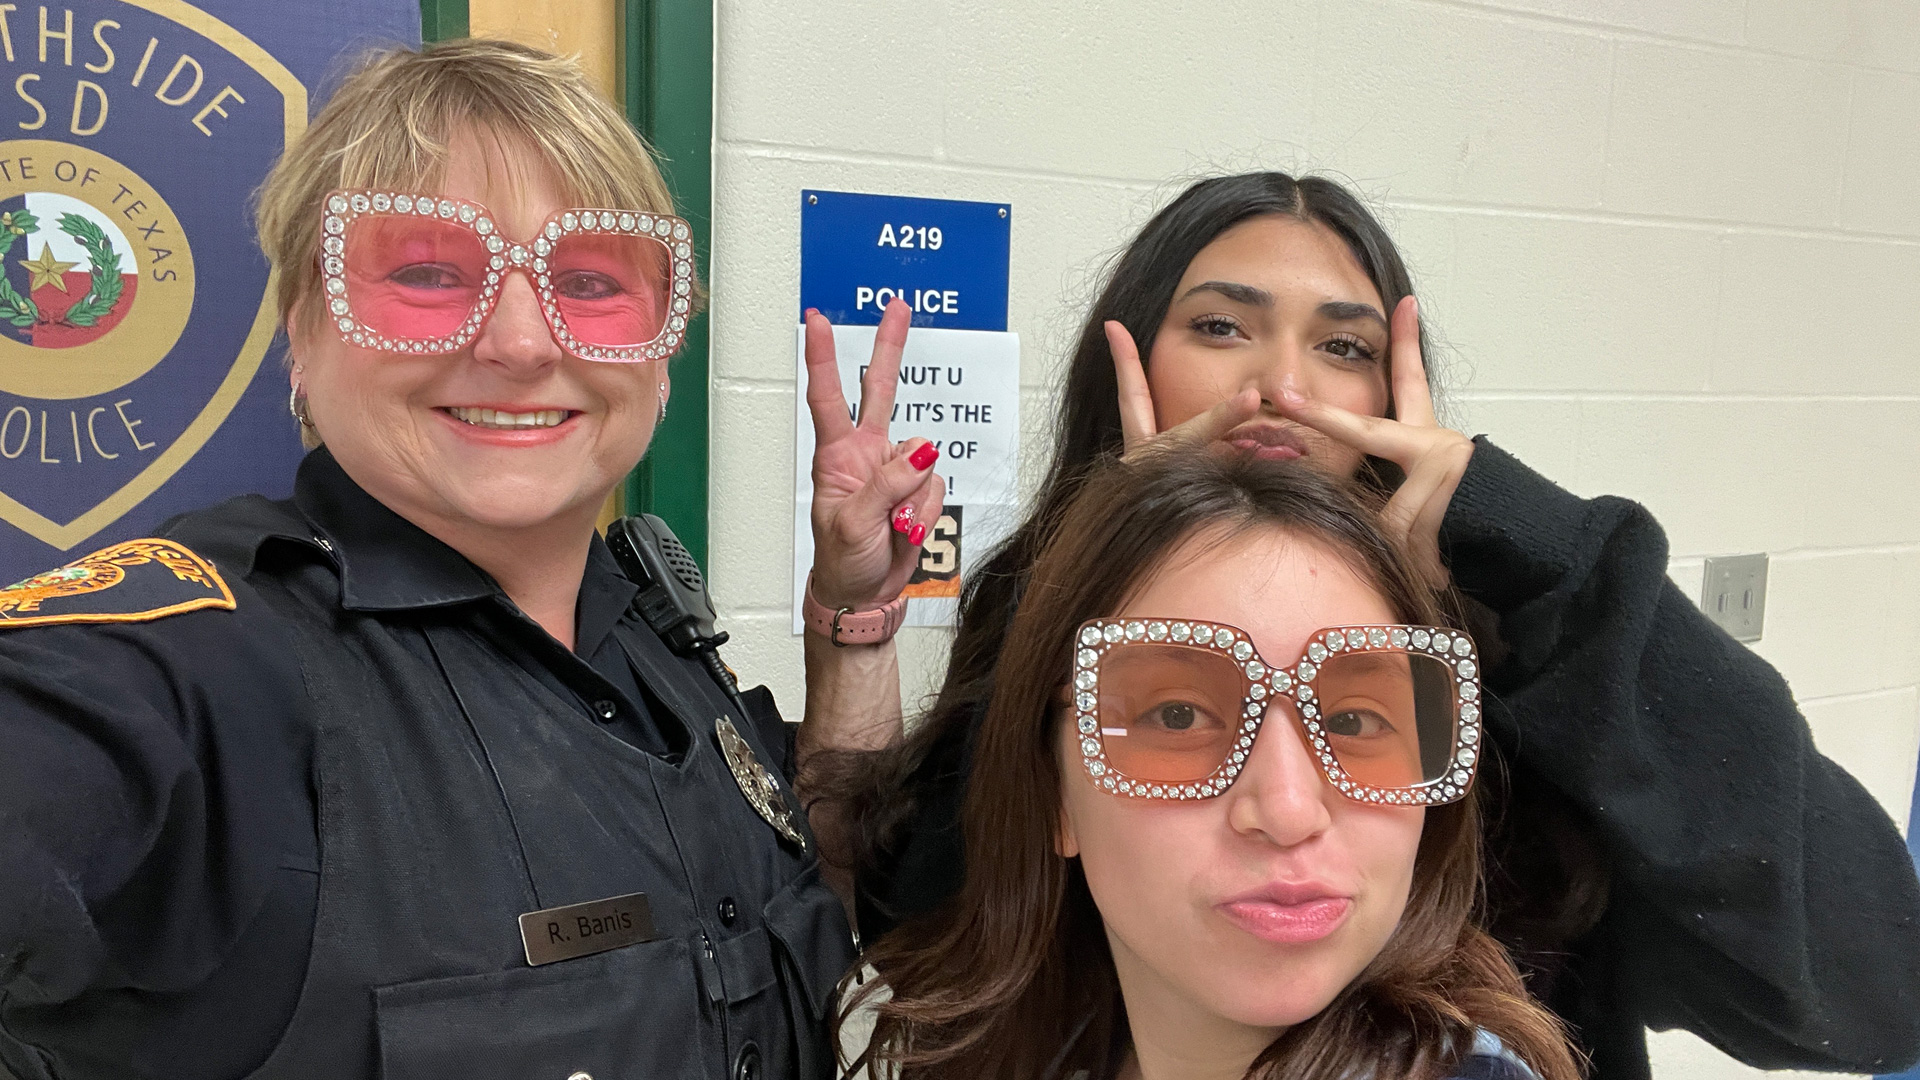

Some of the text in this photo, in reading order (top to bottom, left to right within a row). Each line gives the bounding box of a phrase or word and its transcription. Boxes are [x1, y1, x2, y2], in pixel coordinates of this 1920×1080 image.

[55, 160, 100, 187] OF
[112, 183, 177, 282] TEXAS
[877, 223, 943, 250] A219
[860, 365, 962, 386] NUT U
[906, 402, 944, 422] IT'S
[951, 404, 992, 423] THE
[948, 440, 977, 459] OF
[547, 909, 633, 945] R. Banis
